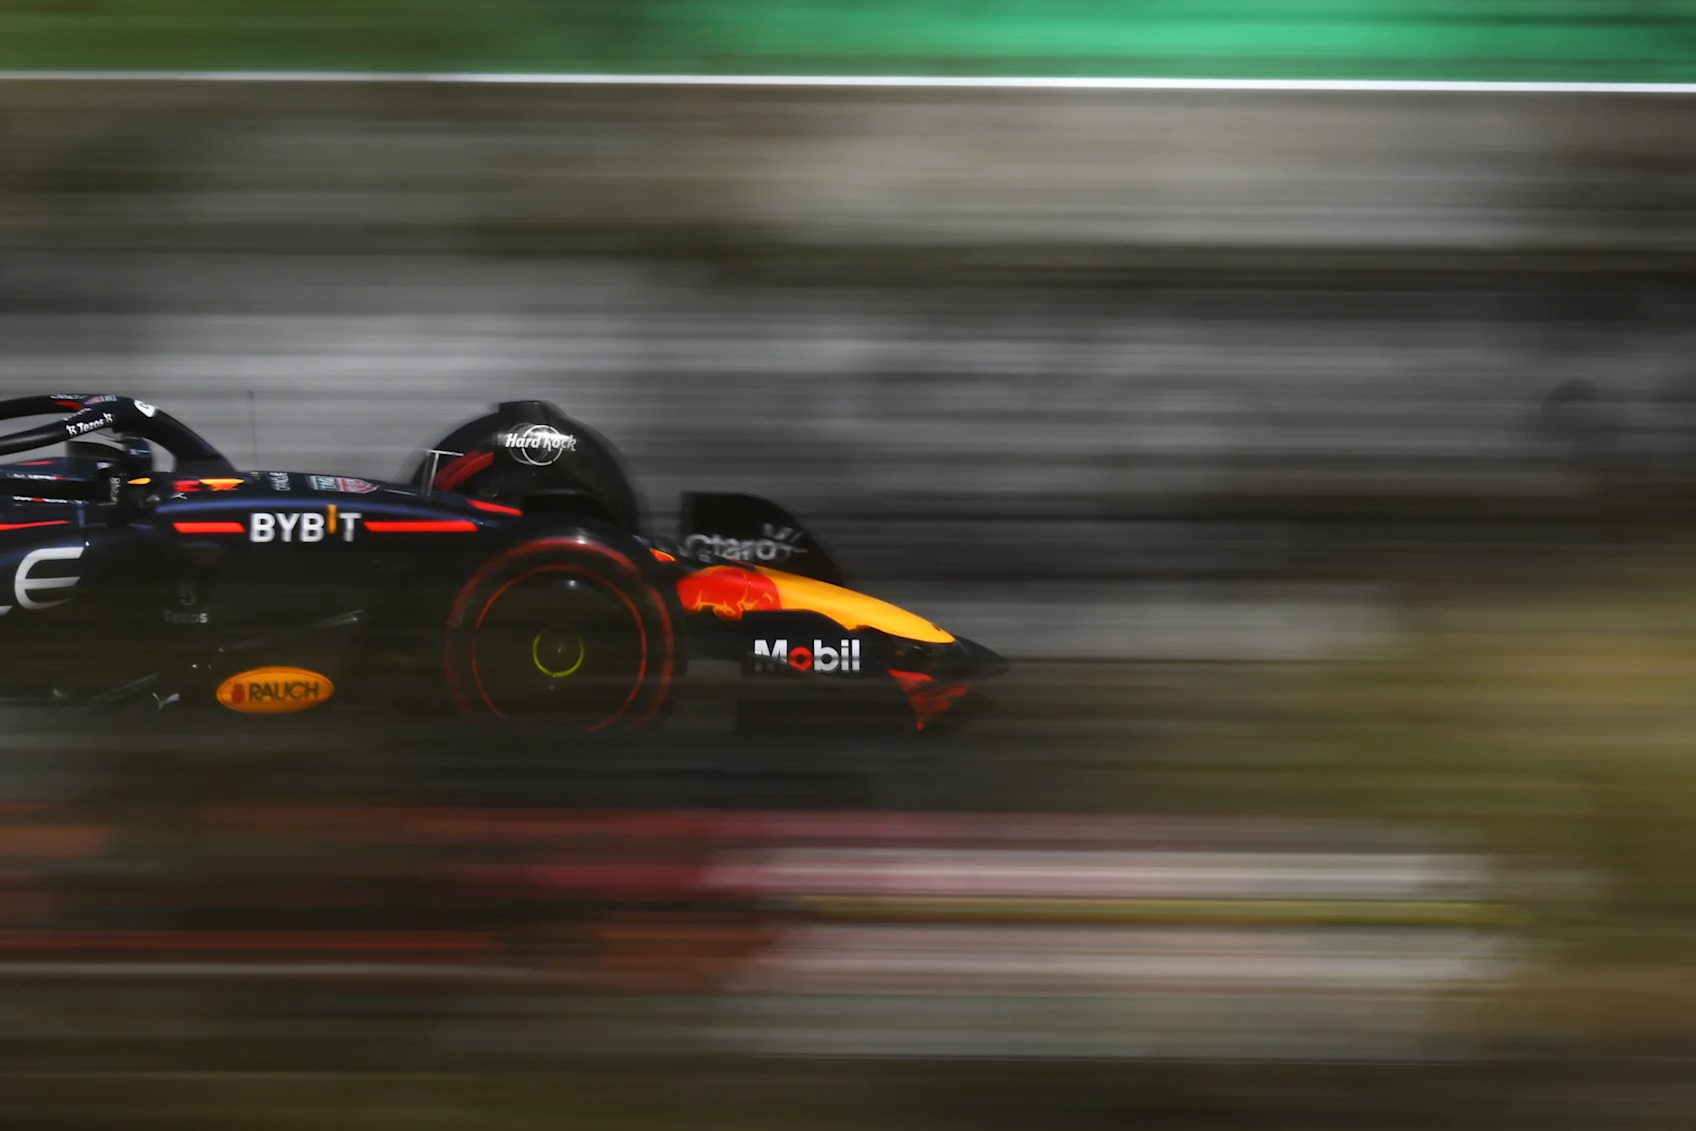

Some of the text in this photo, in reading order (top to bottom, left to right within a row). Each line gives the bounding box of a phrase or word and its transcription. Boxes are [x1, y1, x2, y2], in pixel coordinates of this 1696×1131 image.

[76, 418, 105, 433] Tezos
[505, 432, 541, 449] Hard
[249, 503, 362, 543] BYBIT
[754, 639, 861, 673] Mobil
[248, 682, 319, 701] RAUCH
